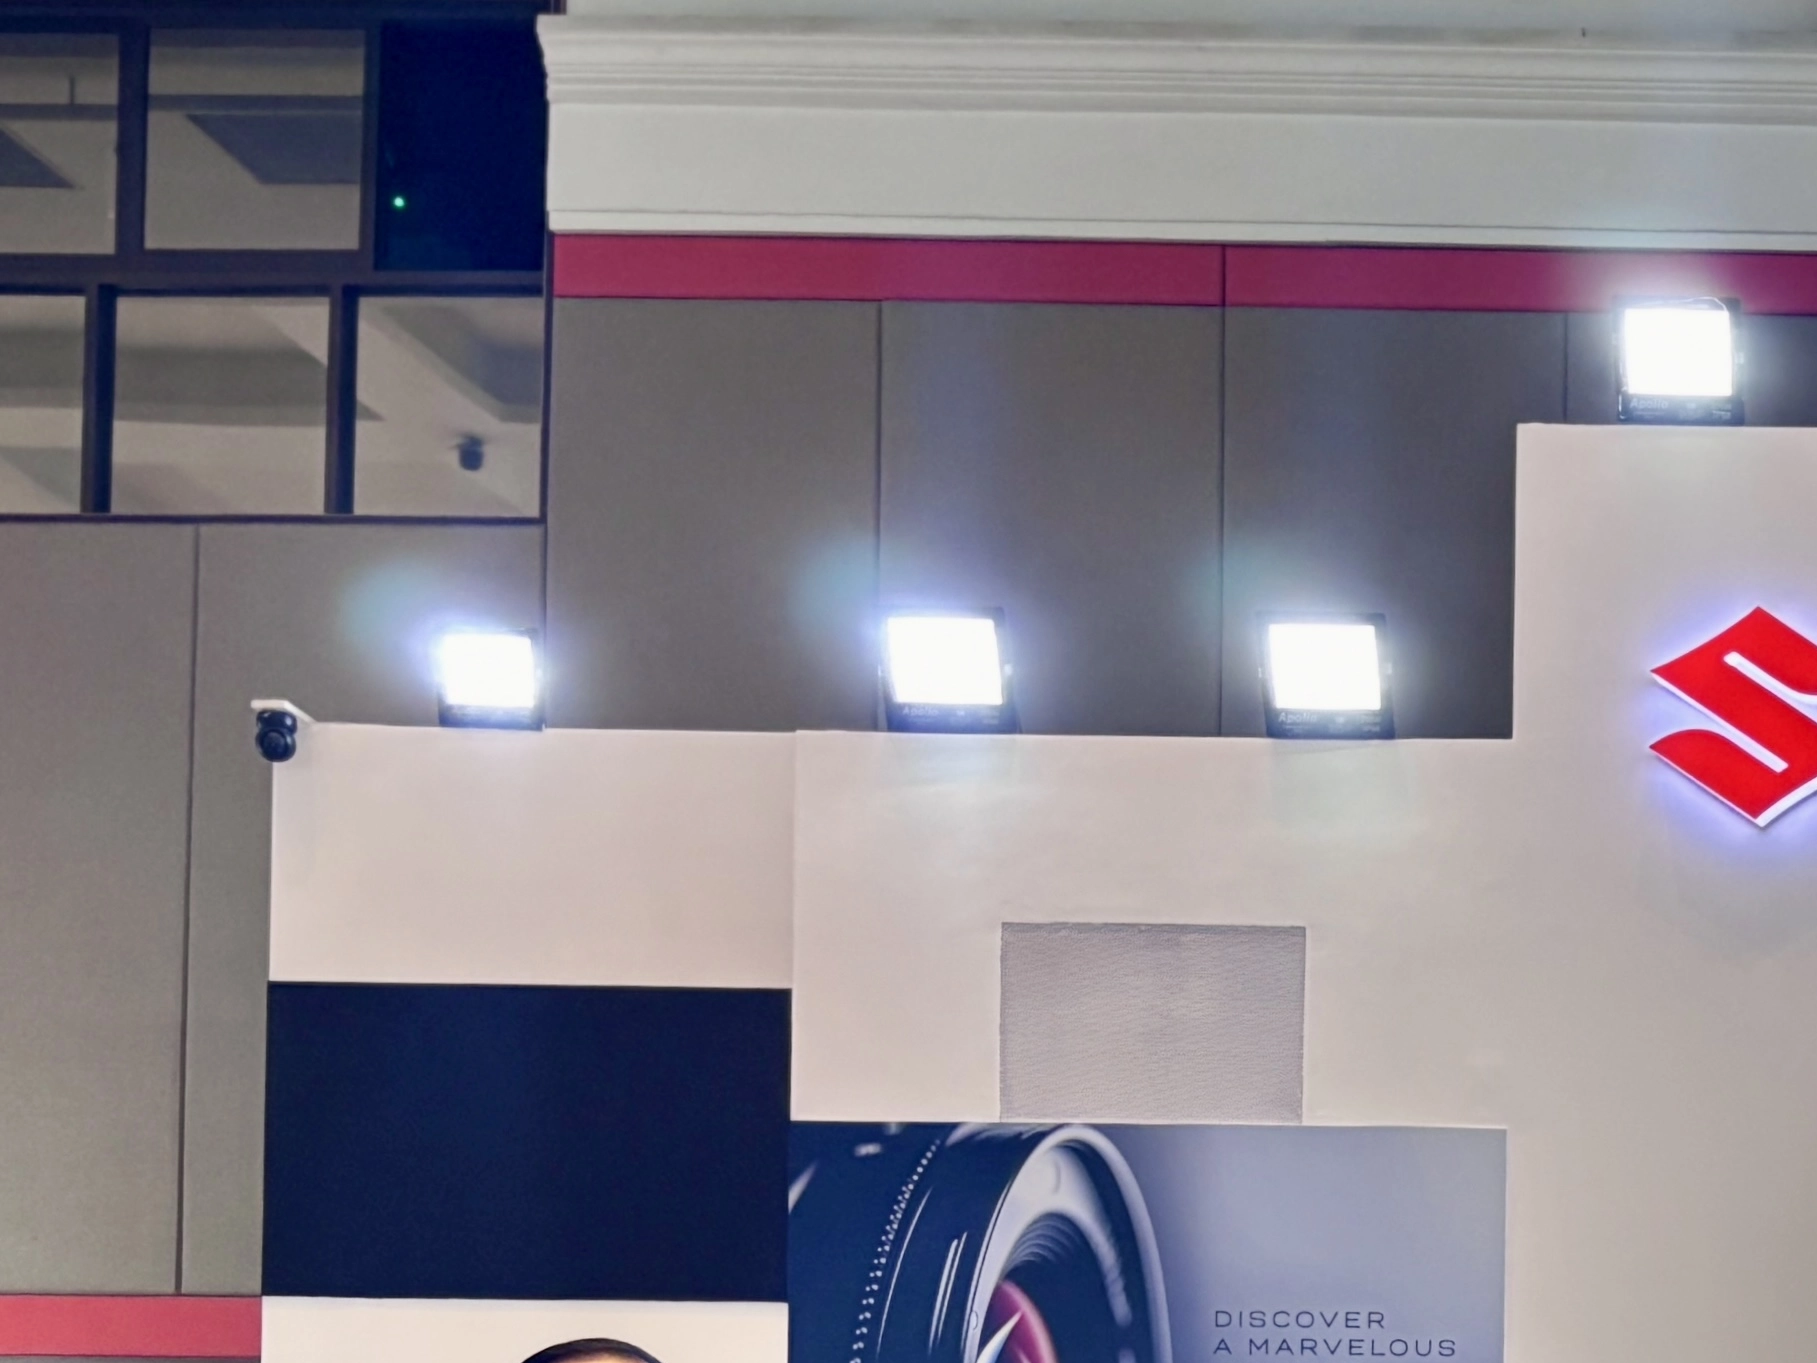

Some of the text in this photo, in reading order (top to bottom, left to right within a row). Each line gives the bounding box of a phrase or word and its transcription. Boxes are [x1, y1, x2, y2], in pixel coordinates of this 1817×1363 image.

[1214, 1311, 1385, 1329] DISCOVER
[1212, 1339, 1457, 1358] A MARVELOUS
